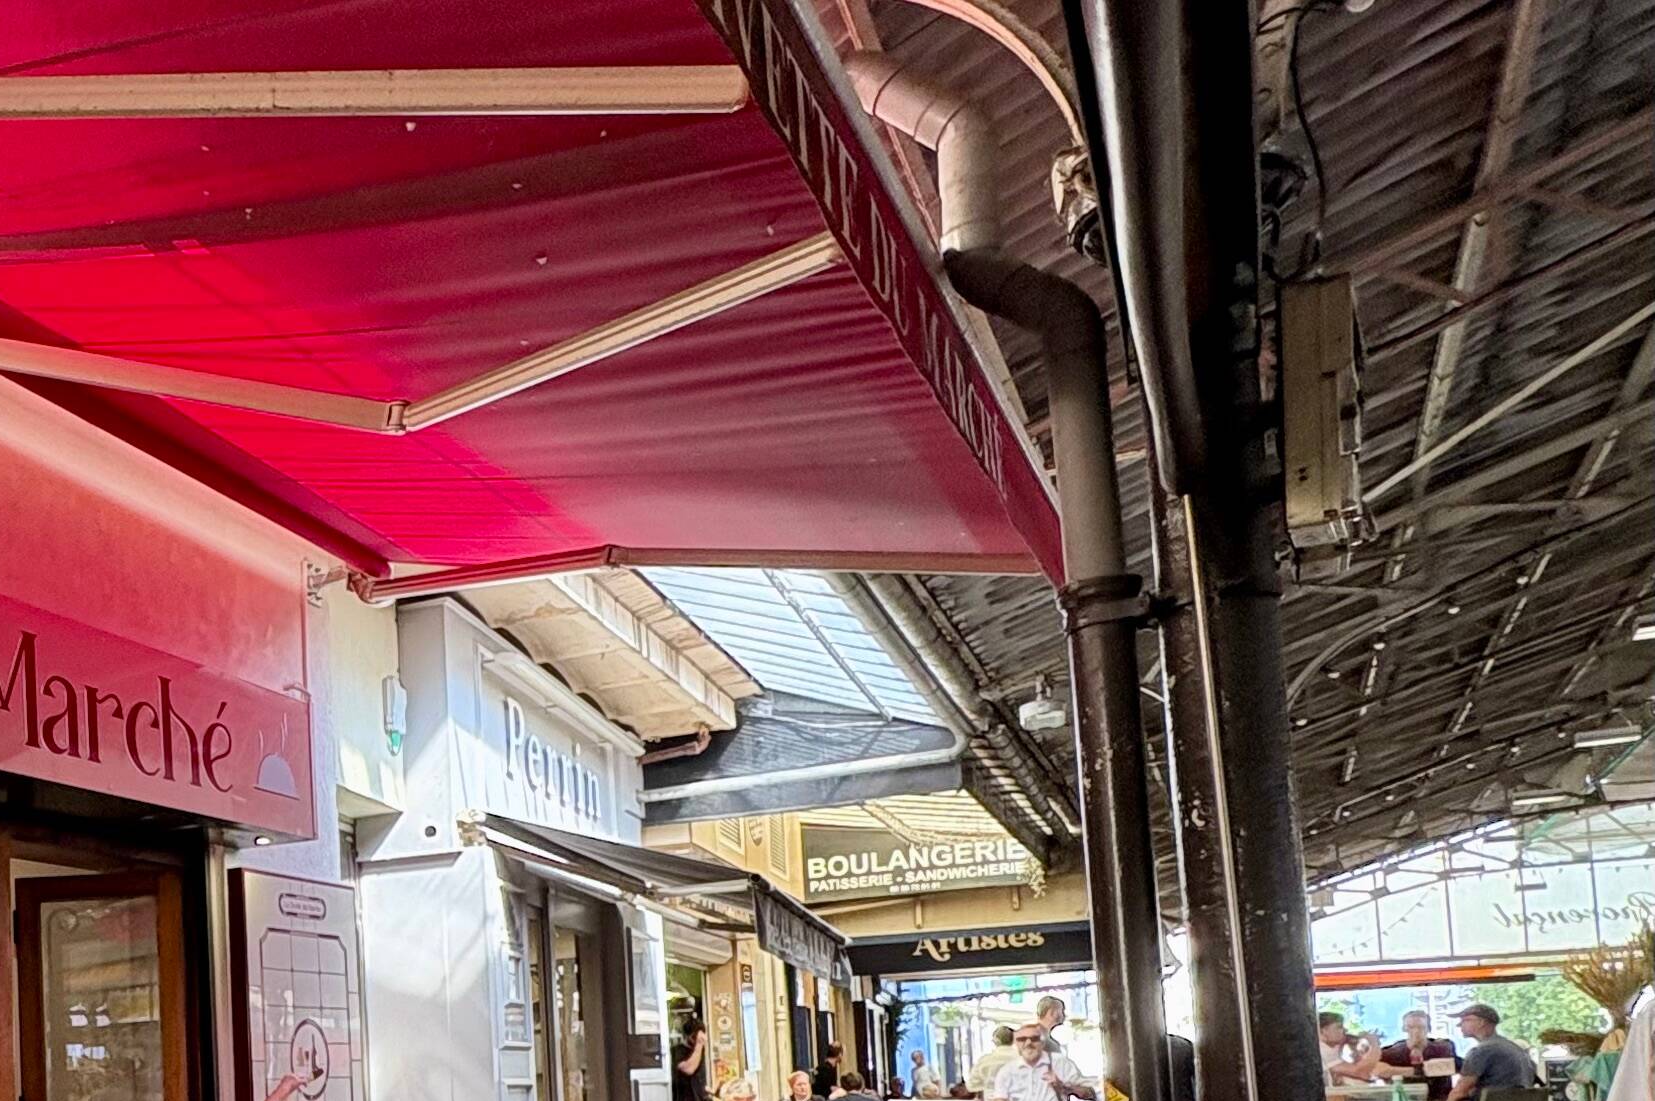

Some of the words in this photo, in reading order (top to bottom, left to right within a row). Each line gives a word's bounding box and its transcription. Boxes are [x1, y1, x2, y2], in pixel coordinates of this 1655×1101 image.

[869, 190, 910, 336] DU
[503, 696, 601, 822] Perrin
[807, 838, 1027, 880] BOULANGERIE
[809, 872, 893, 893] PATISSERIE
[904, 861, 1026, 884] SANDWICHERIE
